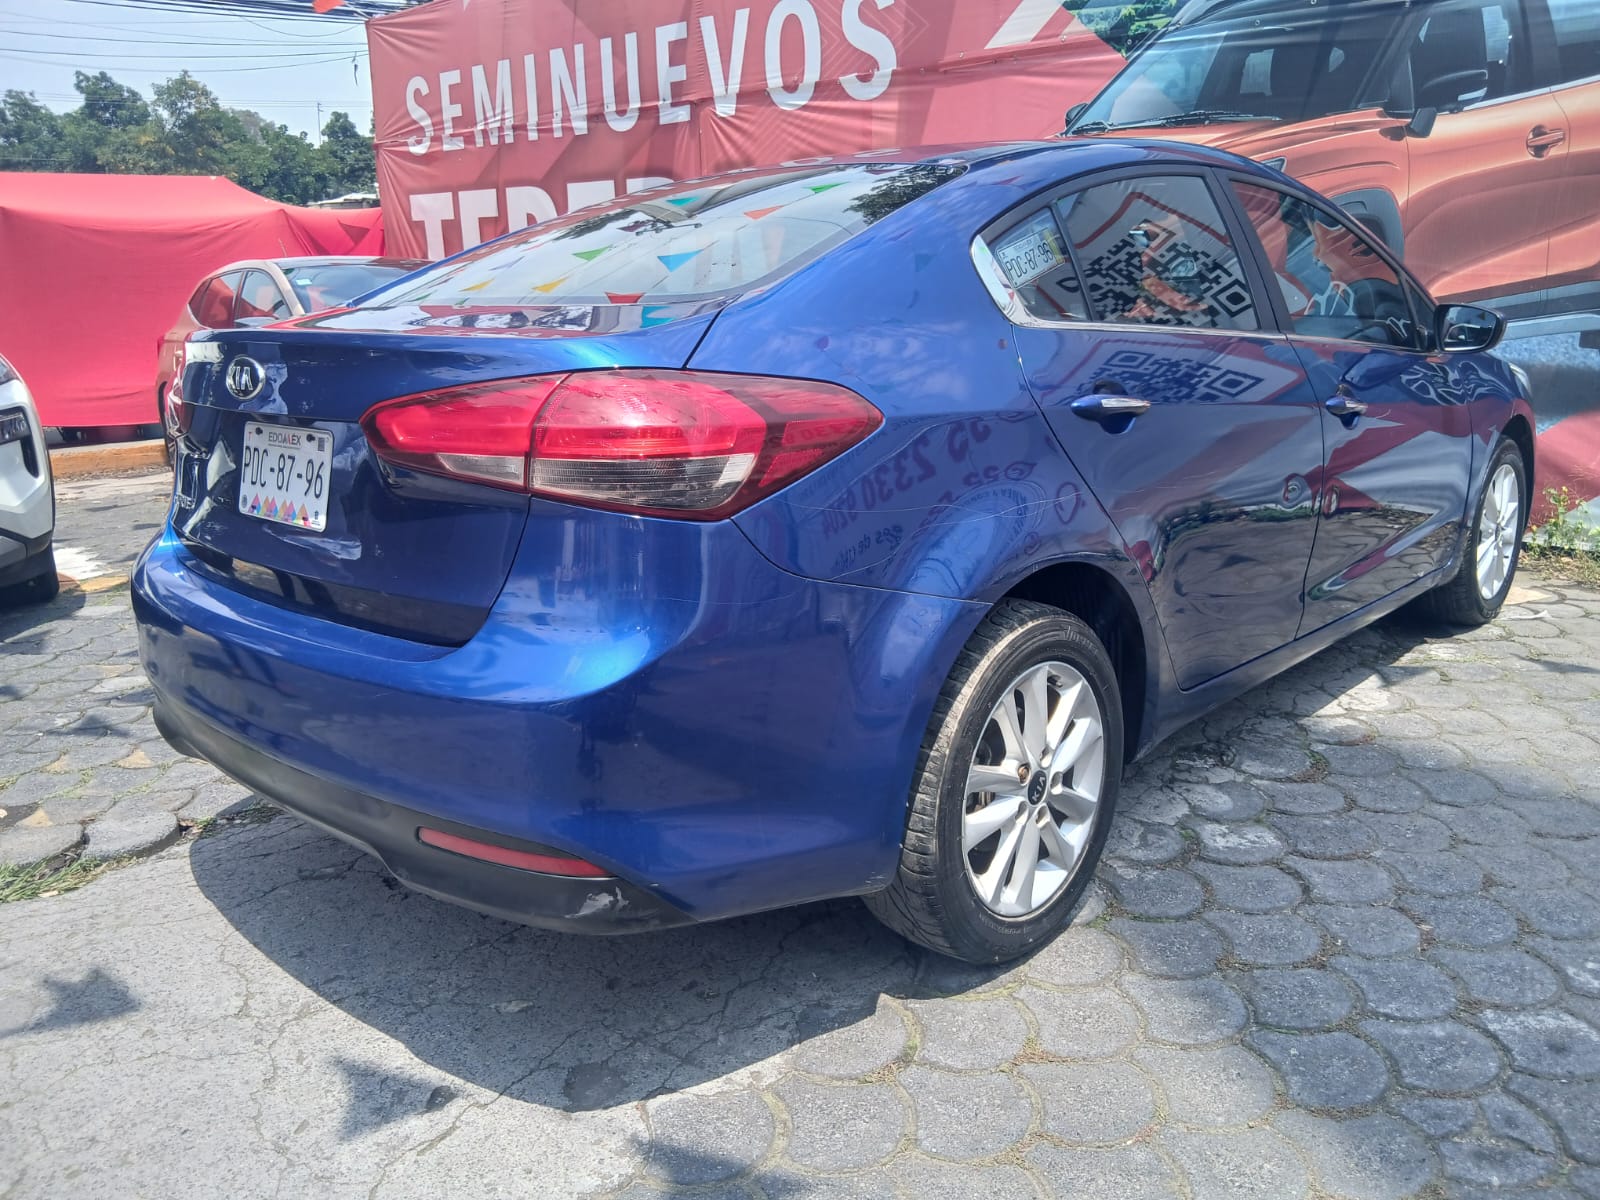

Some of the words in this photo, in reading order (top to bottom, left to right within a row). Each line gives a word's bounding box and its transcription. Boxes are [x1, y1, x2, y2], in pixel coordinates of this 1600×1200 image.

[405, 0, 898, 156] SEMINUEVOS
[1005, 242, 1053, 280] PDC-87-96
[228, 366, 254, 391] KIA
[242, 445, 325, 499] PDC-87-96
[1032, 776, 1046, 802] KIA
